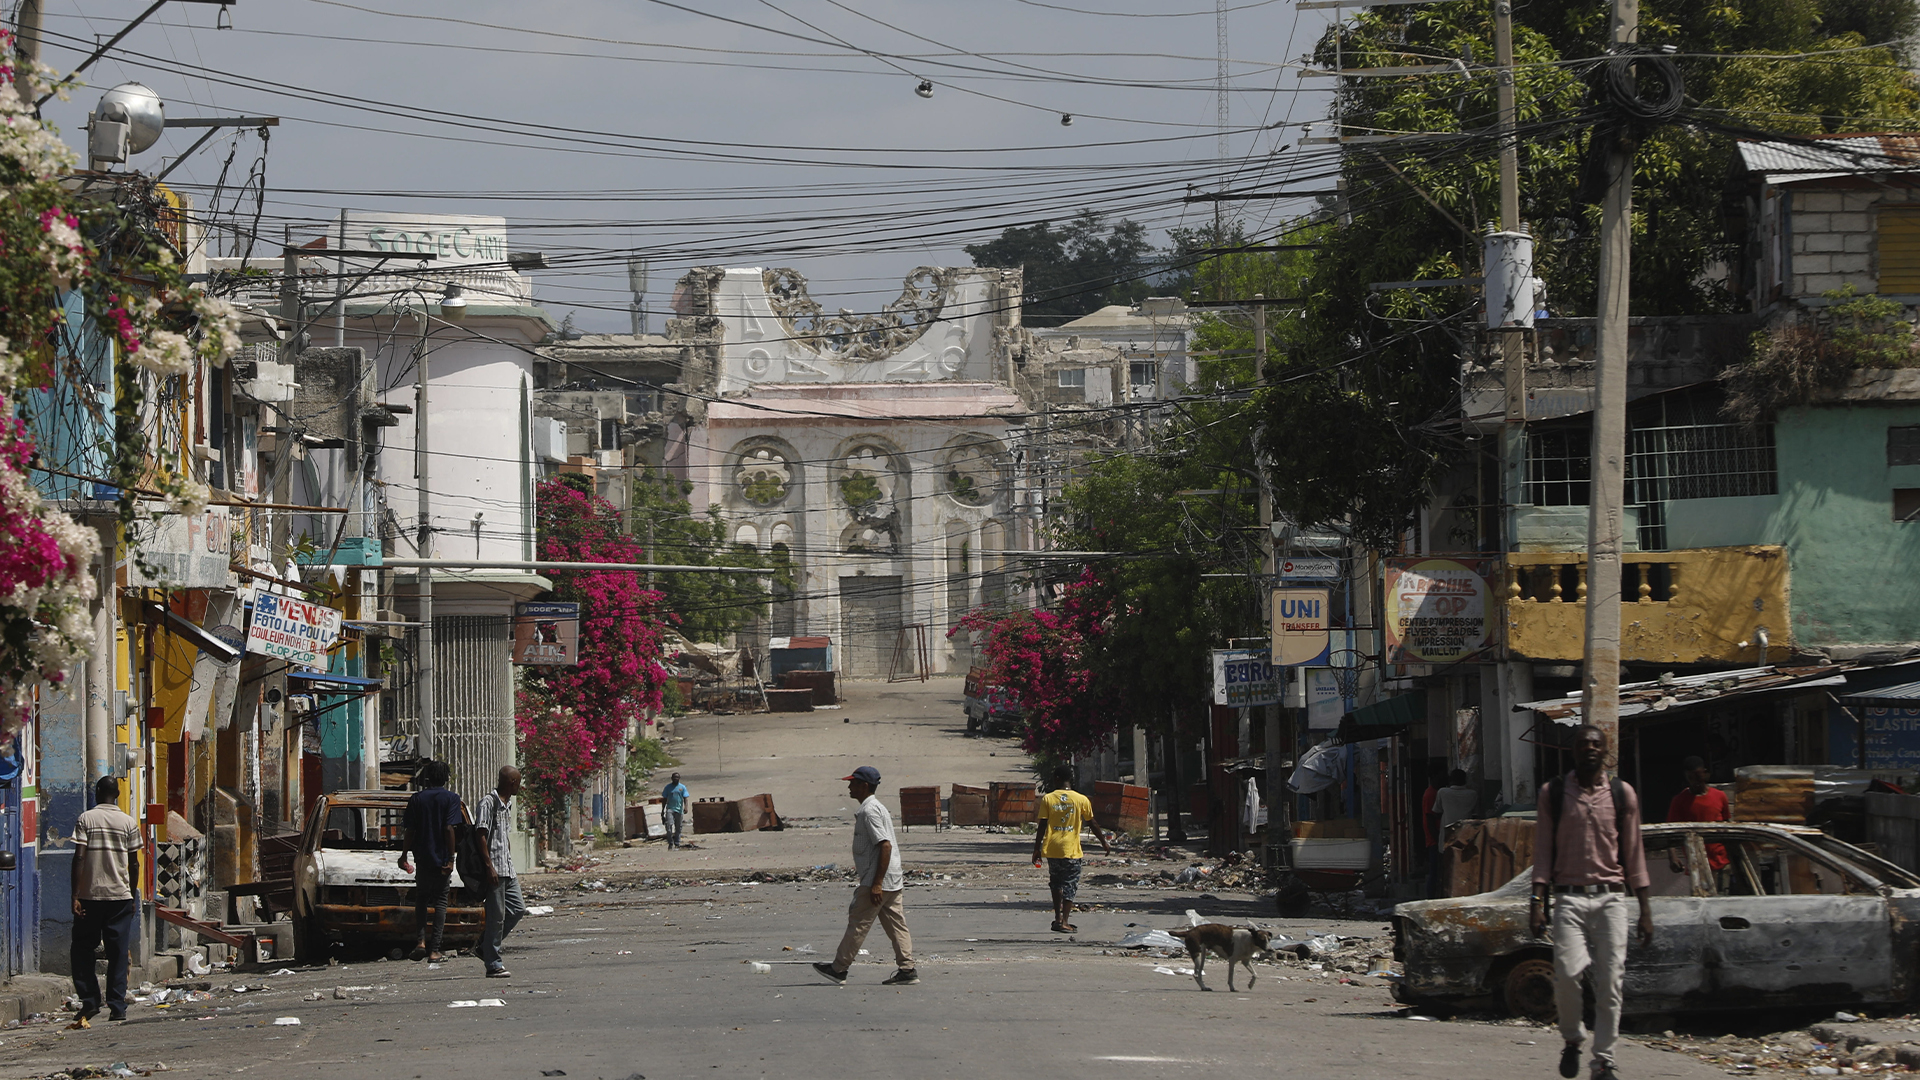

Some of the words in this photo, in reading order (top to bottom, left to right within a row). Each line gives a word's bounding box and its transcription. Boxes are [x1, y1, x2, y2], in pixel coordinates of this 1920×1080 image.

[1294, 563, 1333, 573] MoneyGram
[279, 598, 335, 629] VENUS
[1280, 599, 1320, 619] UNI
[254, 613, 282, 630] FOTO
[283, 620, 296, 635] LA
[299, 623, 320, 640] POU
[1280, 622, 1320, 631] TRANSFER
[1399, 618, 1428, 627] CENTRE
[251, 626, 284, 646] COULEUR
[284, 634, 302, 649] NOIR
[302, 638, 311, 651] ET
[1414, 637, 1465, 646] IMPRESSION
[265, 642, 290, 656] PLOP
[292, 649, 316, 663] PLOP
[1225, 661, 1274, 683] EURO
[1851, 734, 1893, 745] VNTE:
